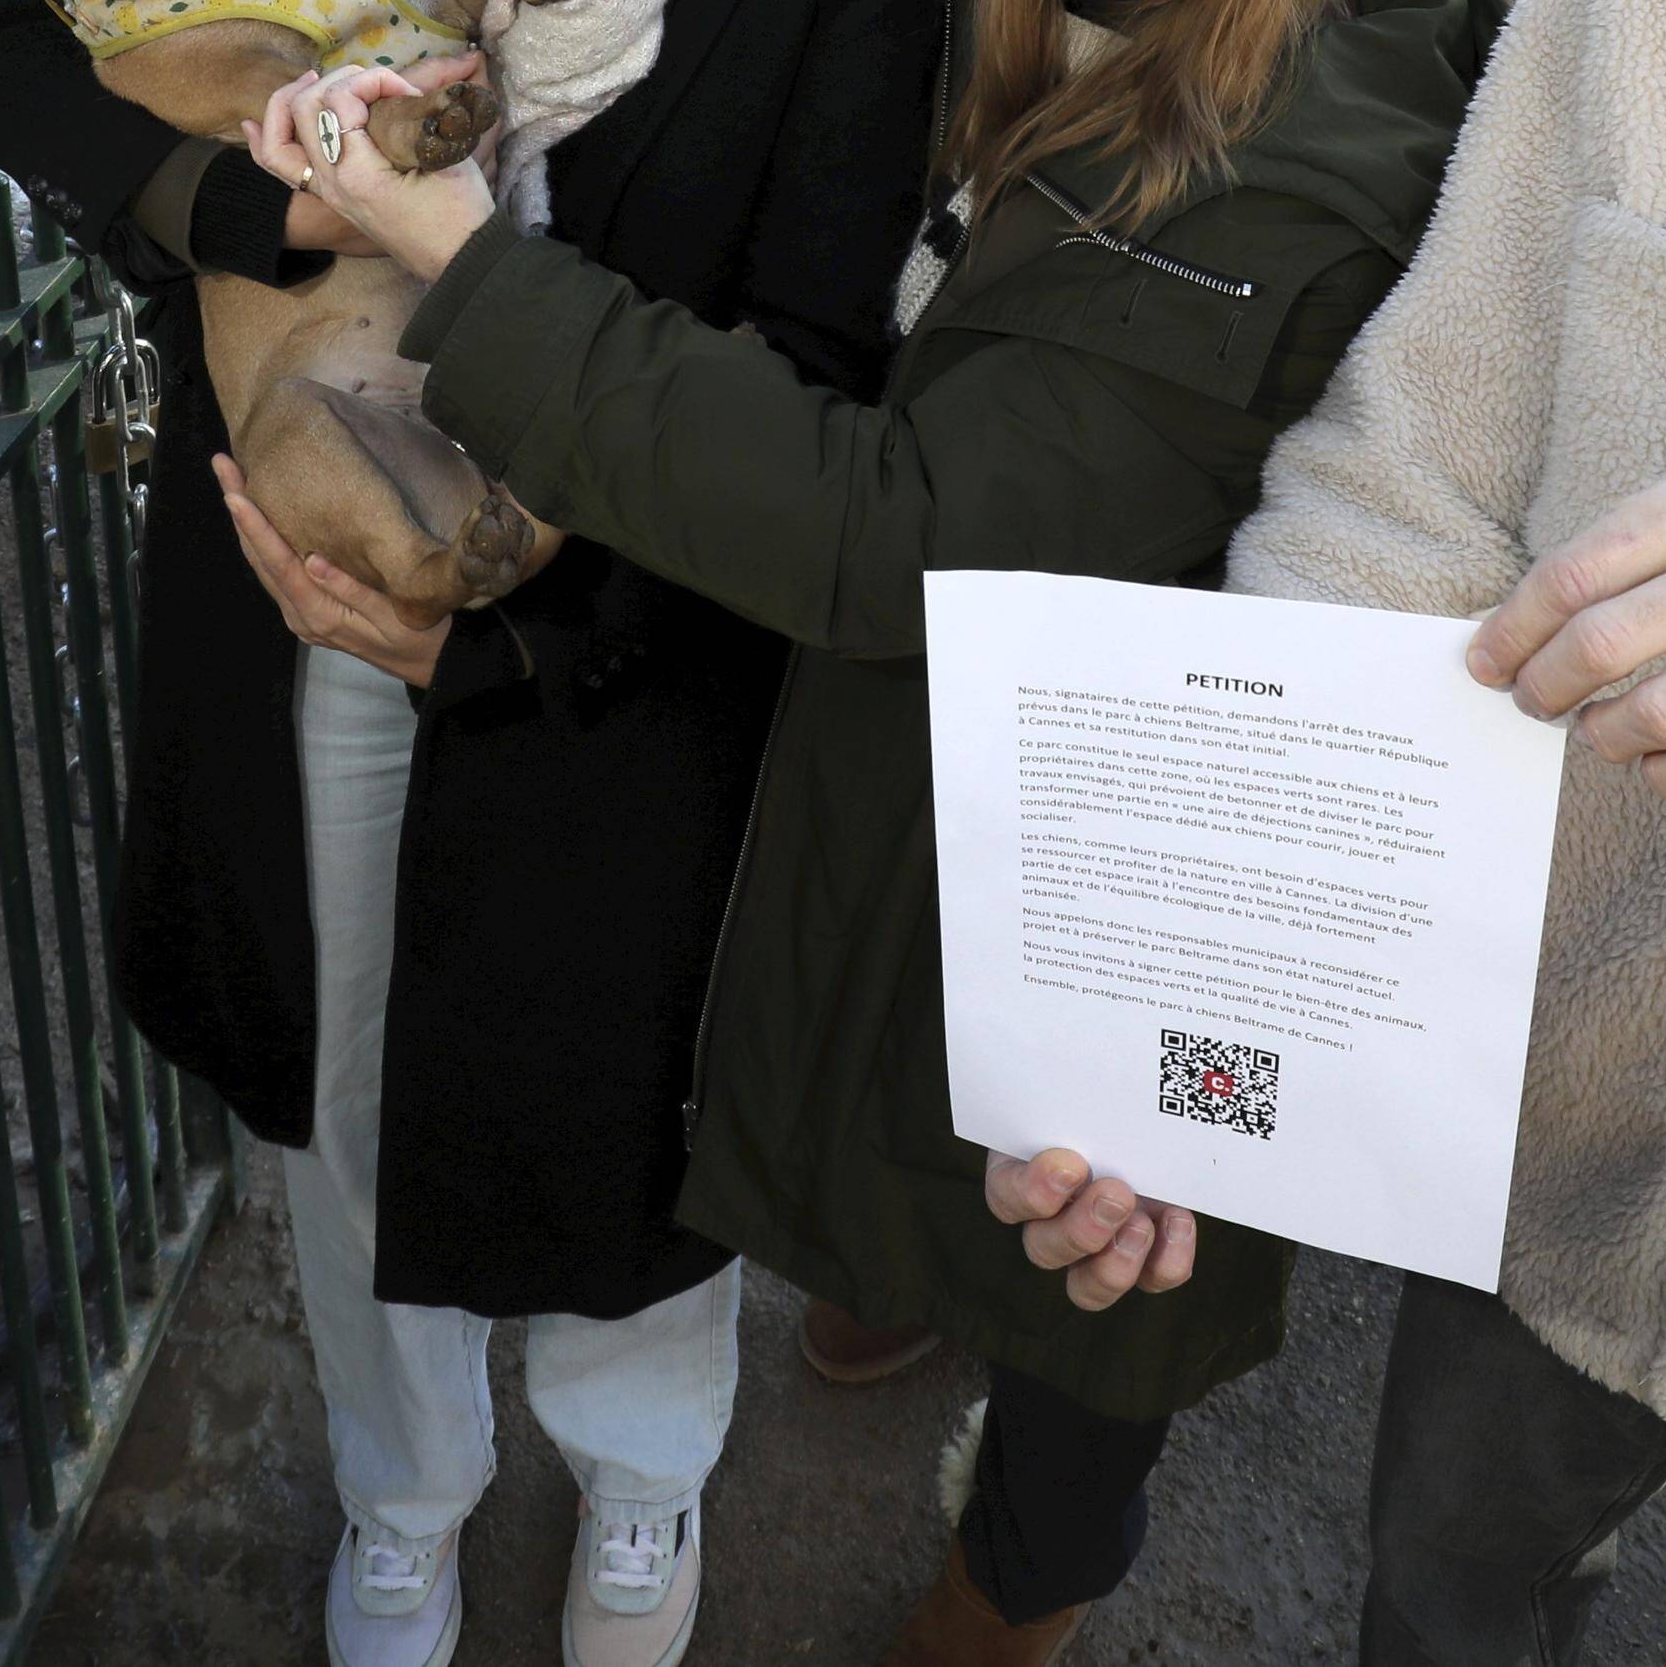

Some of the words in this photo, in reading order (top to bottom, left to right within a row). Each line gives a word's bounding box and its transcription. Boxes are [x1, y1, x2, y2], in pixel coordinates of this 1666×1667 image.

[1018, 686, 1052, 698] Nous,
[1054, 690, 1119, 704] signataires
[1121, 697, 1137, 706] de
[1139, 701, 1170, 711] cette
[1173, 704, 1223, 719] pétition,
[1227, 710, 1299, 728] demandons
[1302, 719, 1339, 733] l'arrêt
[1342, 726, 1364, 737] des
[1367, 730, 1413, 746] travaux
[1186, 673, 1283, 698] PETITION
[1019, 798, 1123, 816] considérablement
[1126, 808, 1173, 824] l'espace
[1175, 816, 1208, 828] dédié
[1211, 823, 1231, 832] aux
[1234, 826, 1273, 840] chiens
[1275, 834, 1303, 845] pour
[1306, 840, 1345, 855] courir,
[1348, 846, 1380, 861] jouer
[1382, 856, 1395, 864] et
[1024, 974, 1079, 993] Ensemble,
[1081, 986, 1144, 1004] protégeons
[1146, 997, 1157, 1007] le
[1159, 1001, 1184, 1012] parc
[1186, 1005, 1193, 1014] à
[1195, 1008, 1231, 1022] chiens
[1233, 1014, 1285, 1034] Beltrame
[1287, 1028, 1302, 1038] de
[1304, 1032, 1346, 1050] Cannes
